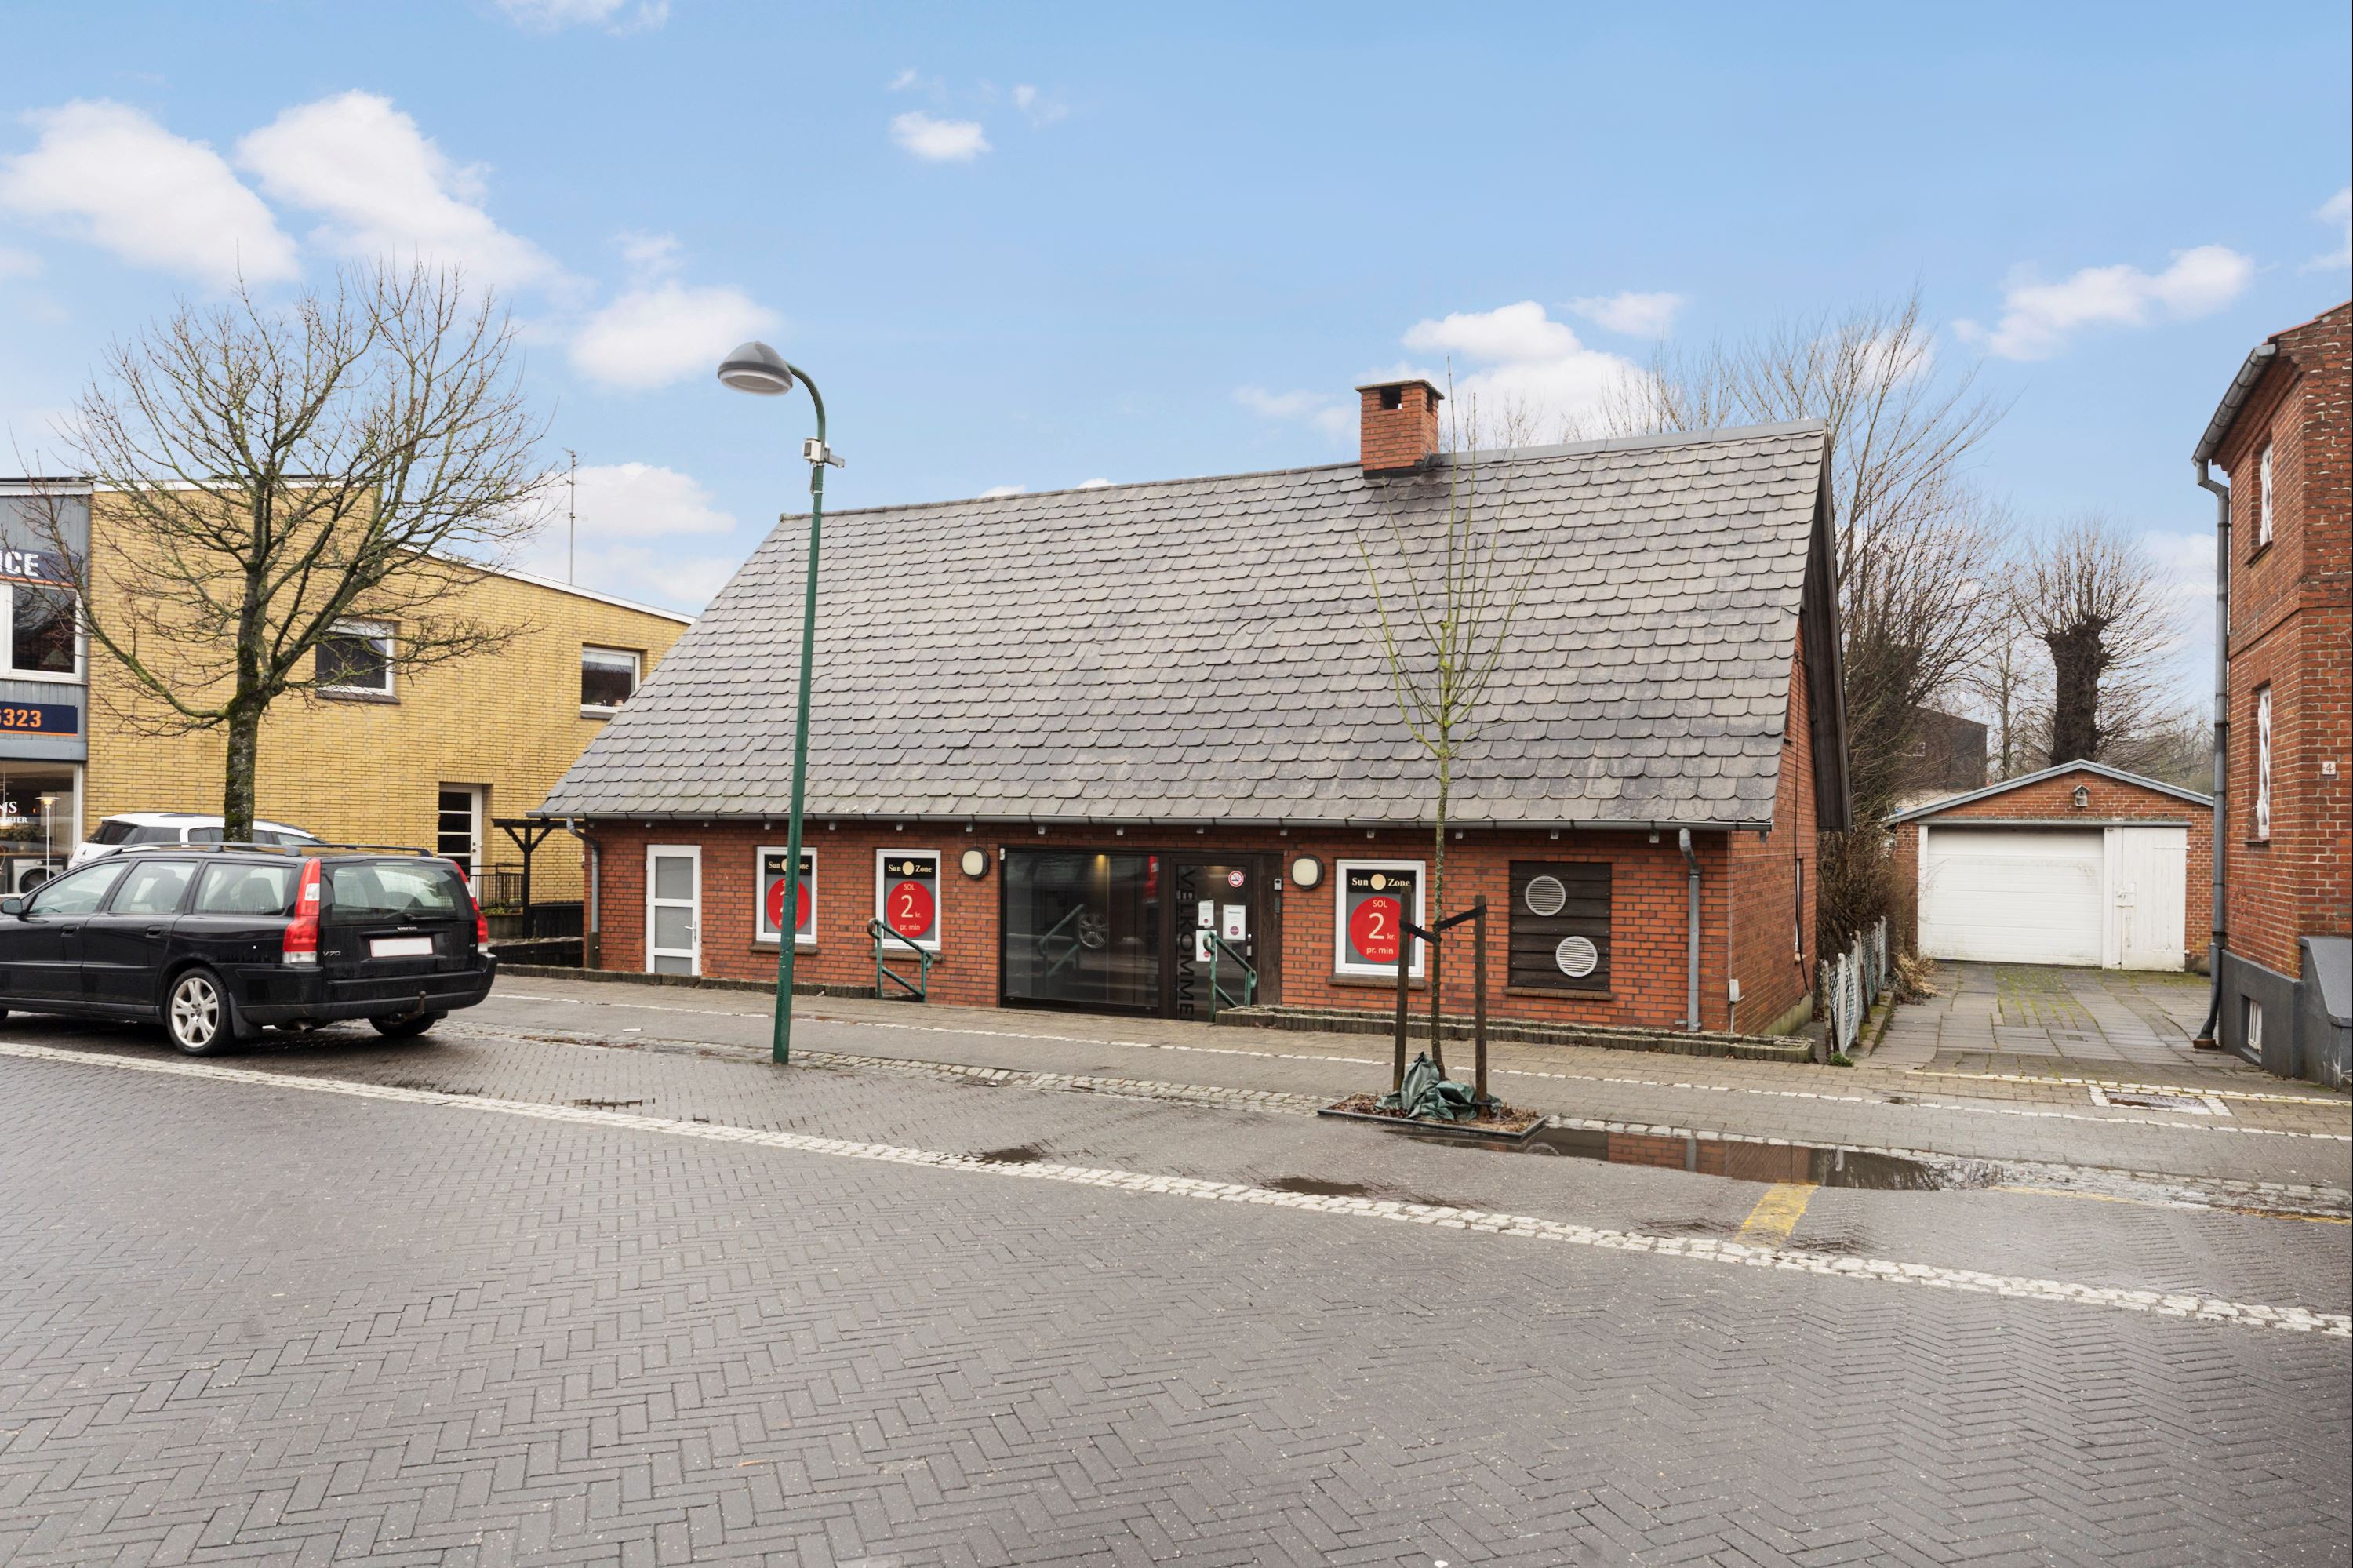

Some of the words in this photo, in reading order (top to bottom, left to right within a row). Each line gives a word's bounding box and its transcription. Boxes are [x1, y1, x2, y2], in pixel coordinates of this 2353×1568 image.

[0, 708, 42, 728] 323
[2326, 763, 2333, 773] 4
[915, 864, 933, 873] Zone
[1351, 877, 1369, 886] Sun
[1387, 878, 1411, 886] Zone
[900, 894, 914, 918] 2
[1368, 912, 1384, 940] 2
[1179, 869, 1195, 1021] VELKOMME
